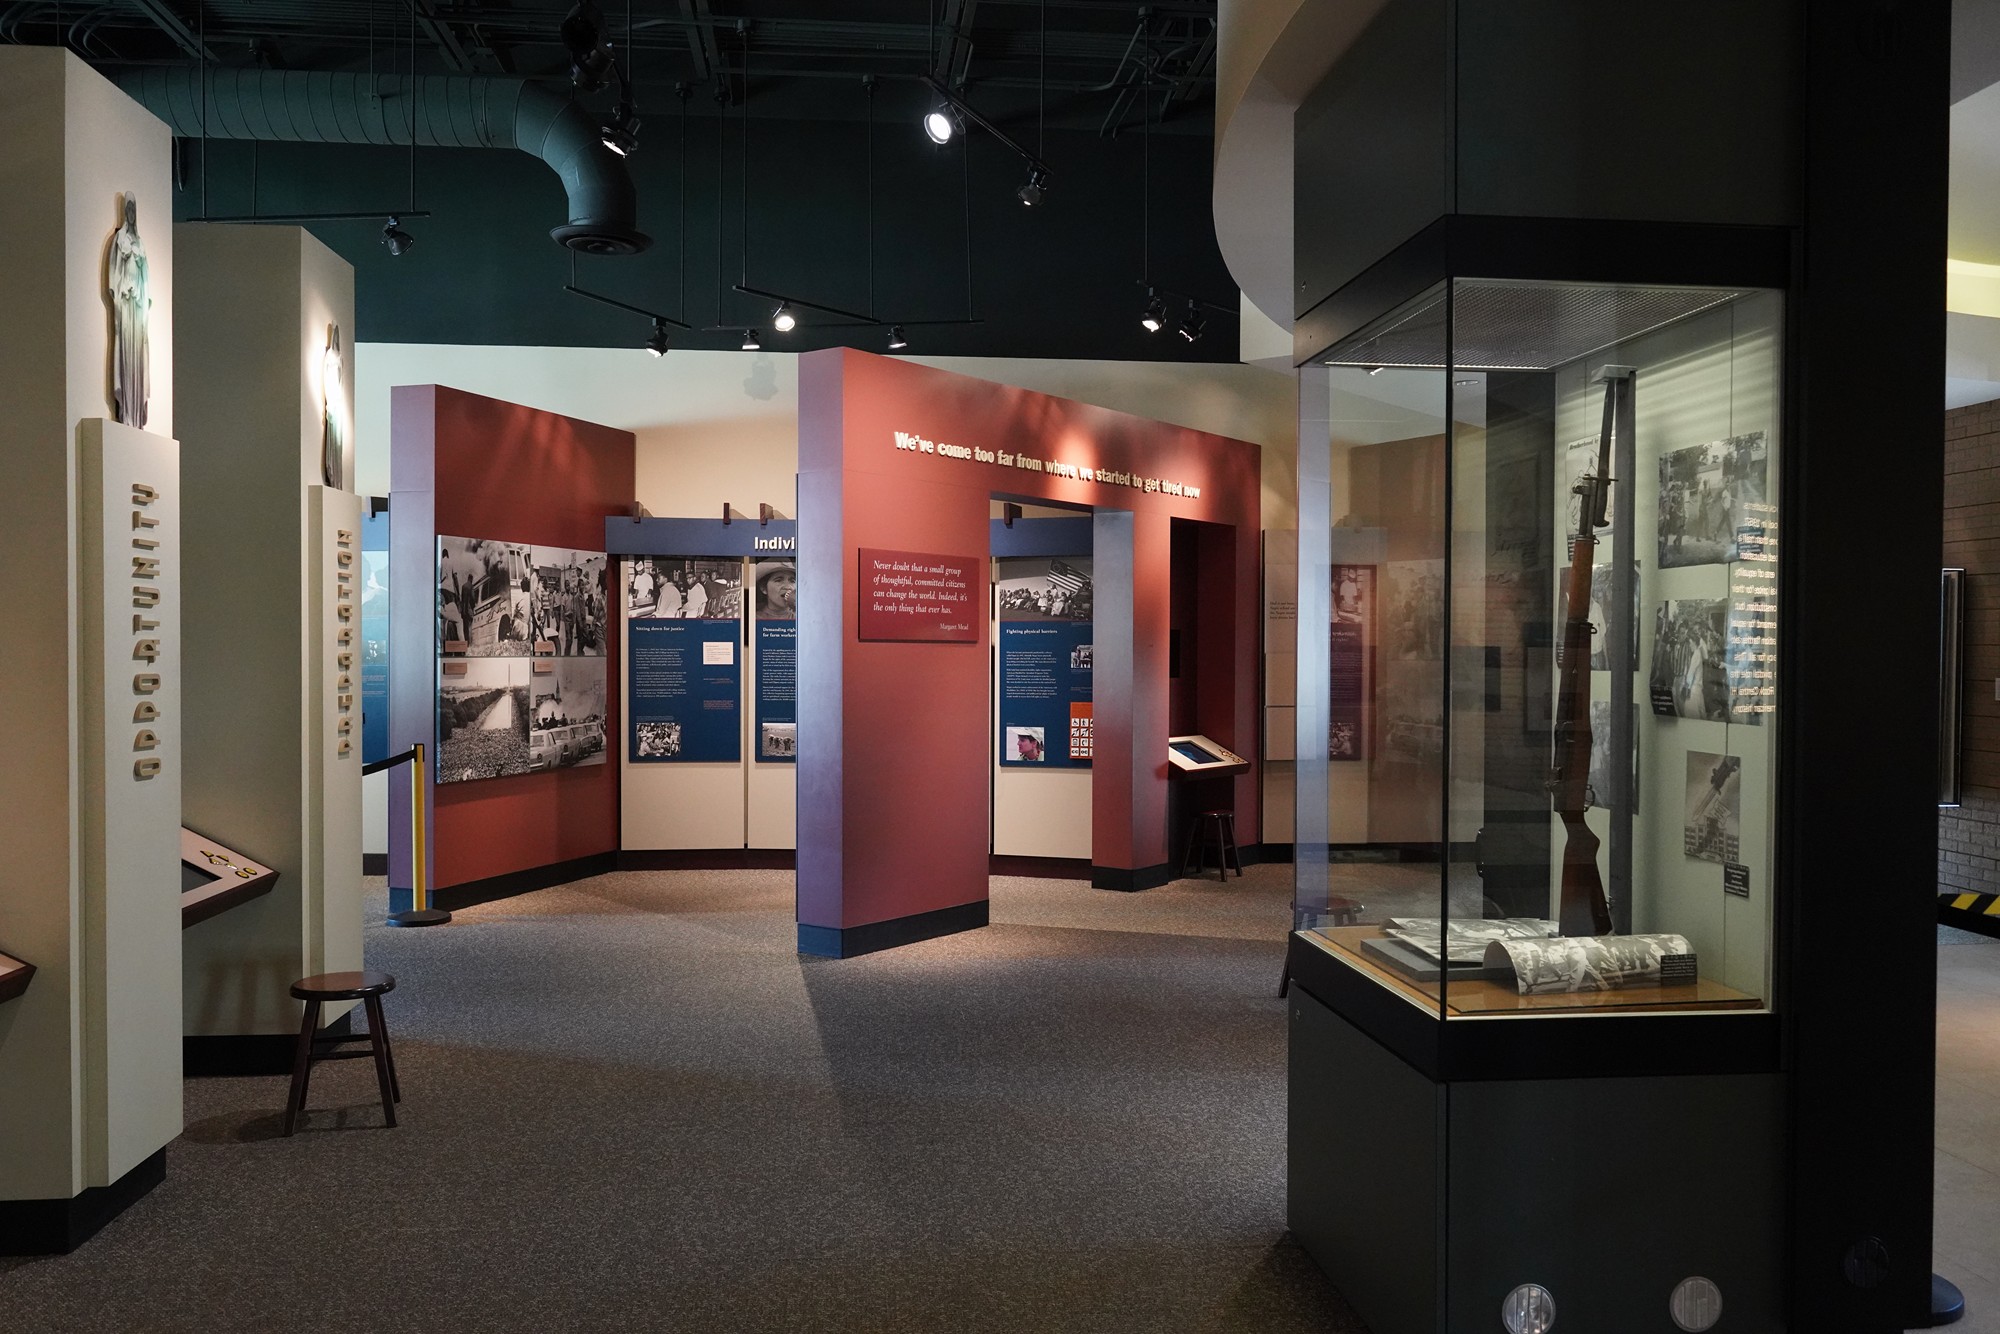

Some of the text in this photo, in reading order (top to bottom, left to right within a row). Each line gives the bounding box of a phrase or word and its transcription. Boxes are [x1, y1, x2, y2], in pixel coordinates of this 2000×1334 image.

[894, 431, 1201, 498] We've come too far from where we started to get tired now
[755, 536, 795, 550] Indivi
[873, 560, 892, 570] Never
[892, 561, 910, 571] doubt
[911, 563, 923, 572] that
[929, 565, 945, 574] small
[945, 567, 961, 577] group
[873, 574, 966, 588] of thoughtful, committed citizens
[886, 589, 907, 600] change
[908, 590, 918, 599] the
[919, 591, 936, 600] world.
[938, 592, 958, 602] Indeed,
[959, 593, 968, 602] it's
[873, 602, 952, 614] the only thing that ever has.
[132, 483, 162, 782] OPPORTUNITY
[940, 623, 957, 631] Margaret
[337, 529, 353, 755] PREPARATION
